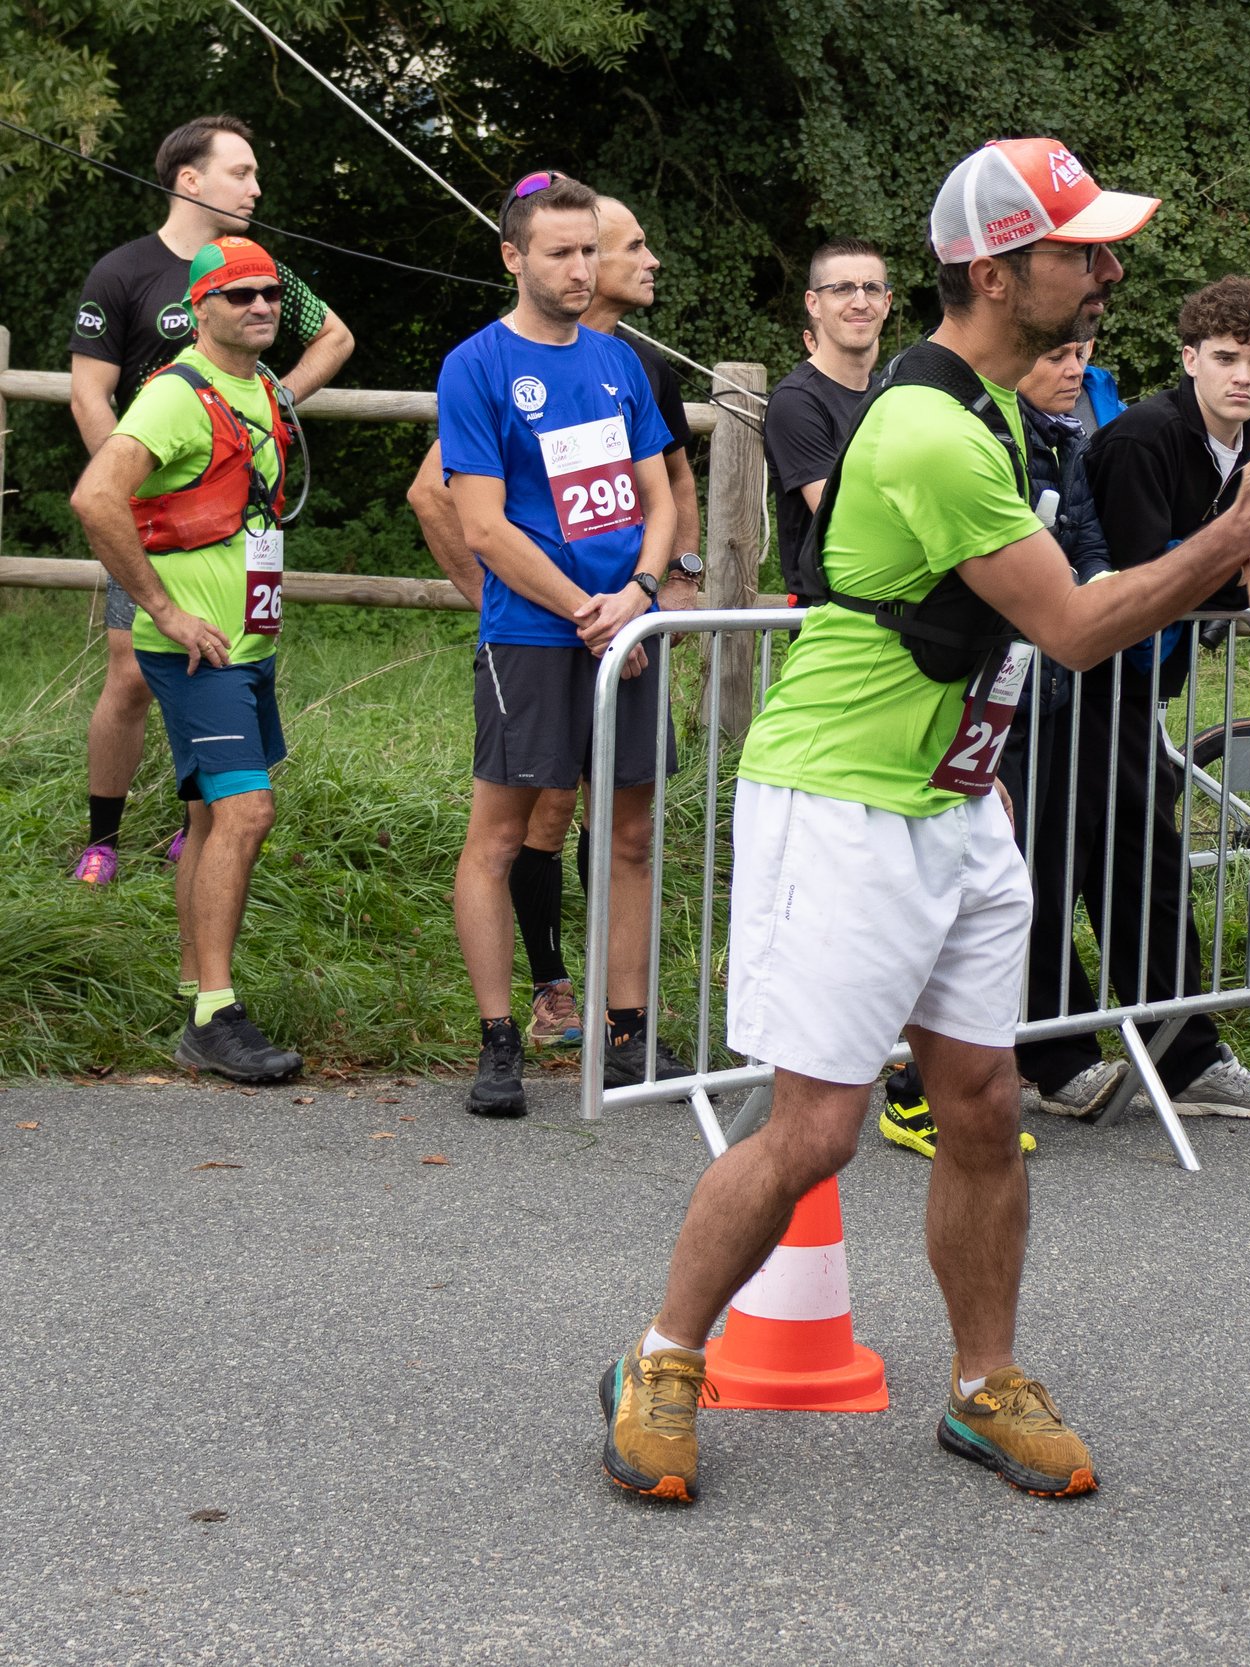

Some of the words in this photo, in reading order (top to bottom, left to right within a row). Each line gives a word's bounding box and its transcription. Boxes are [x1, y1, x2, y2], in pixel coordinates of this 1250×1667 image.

[985, 209, 1031, 233] STRONGER
[990, 222, 1036, 246] TOGETHER
[78, 311, 104, 331] TDR
[162, 313, 189, 330] TDR
[562, 473, 636, 525] 298
[251, 584, 283, 619] 26
[785, 884, 796, 921] ARTENGO
